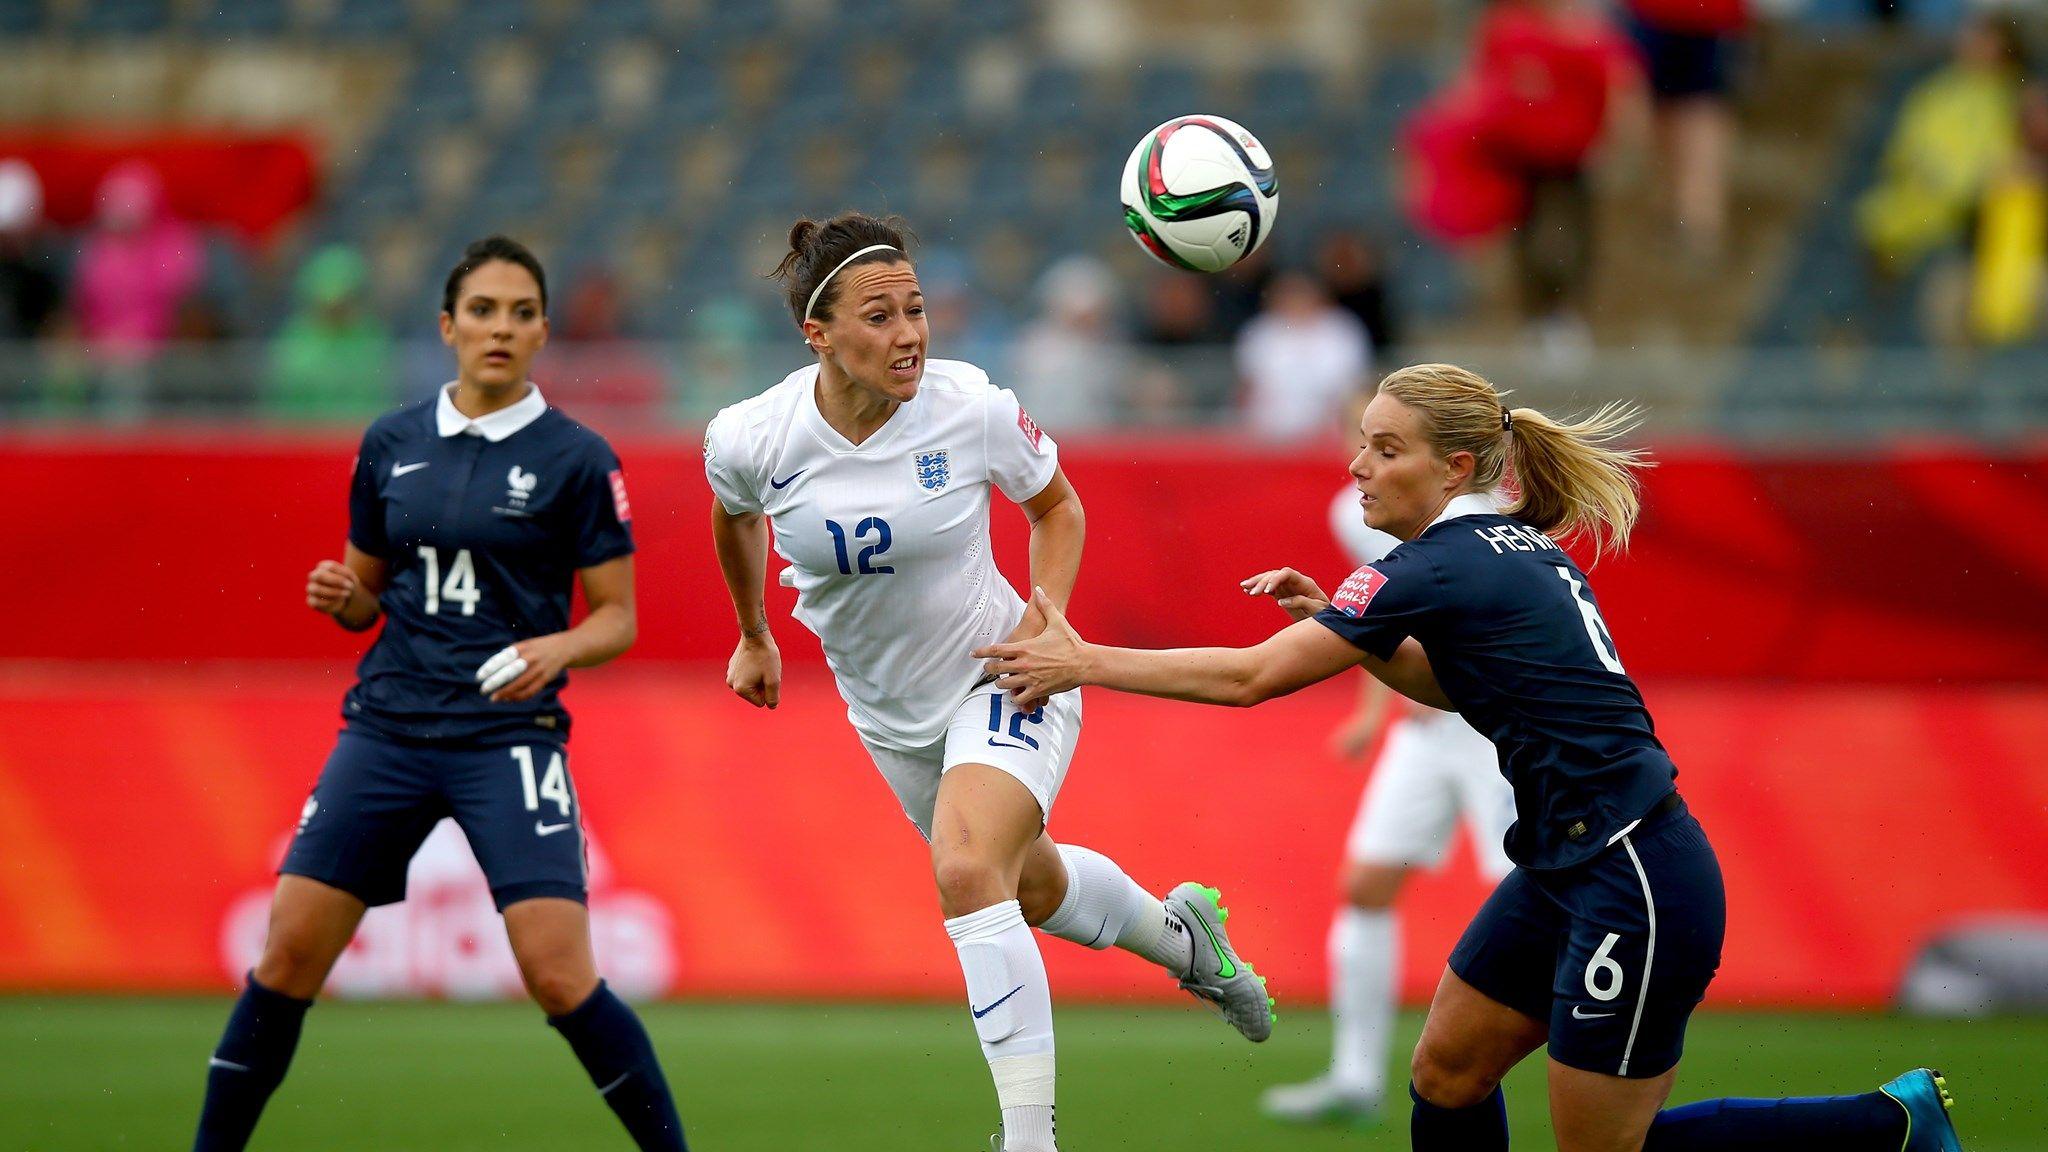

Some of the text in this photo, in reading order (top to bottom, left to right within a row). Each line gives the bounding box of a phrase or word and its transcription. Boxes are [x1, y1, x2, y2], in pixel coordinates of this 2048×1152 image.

[825, 516, 895, 575] 12
[1474, 524, 1564, 555] HENR
[416, 545, 481, 616] 14
[988, 694, 1044, 751] 12
[510, 745, 571, 816] 14
[1584, 932, 1624, 1001] 6
